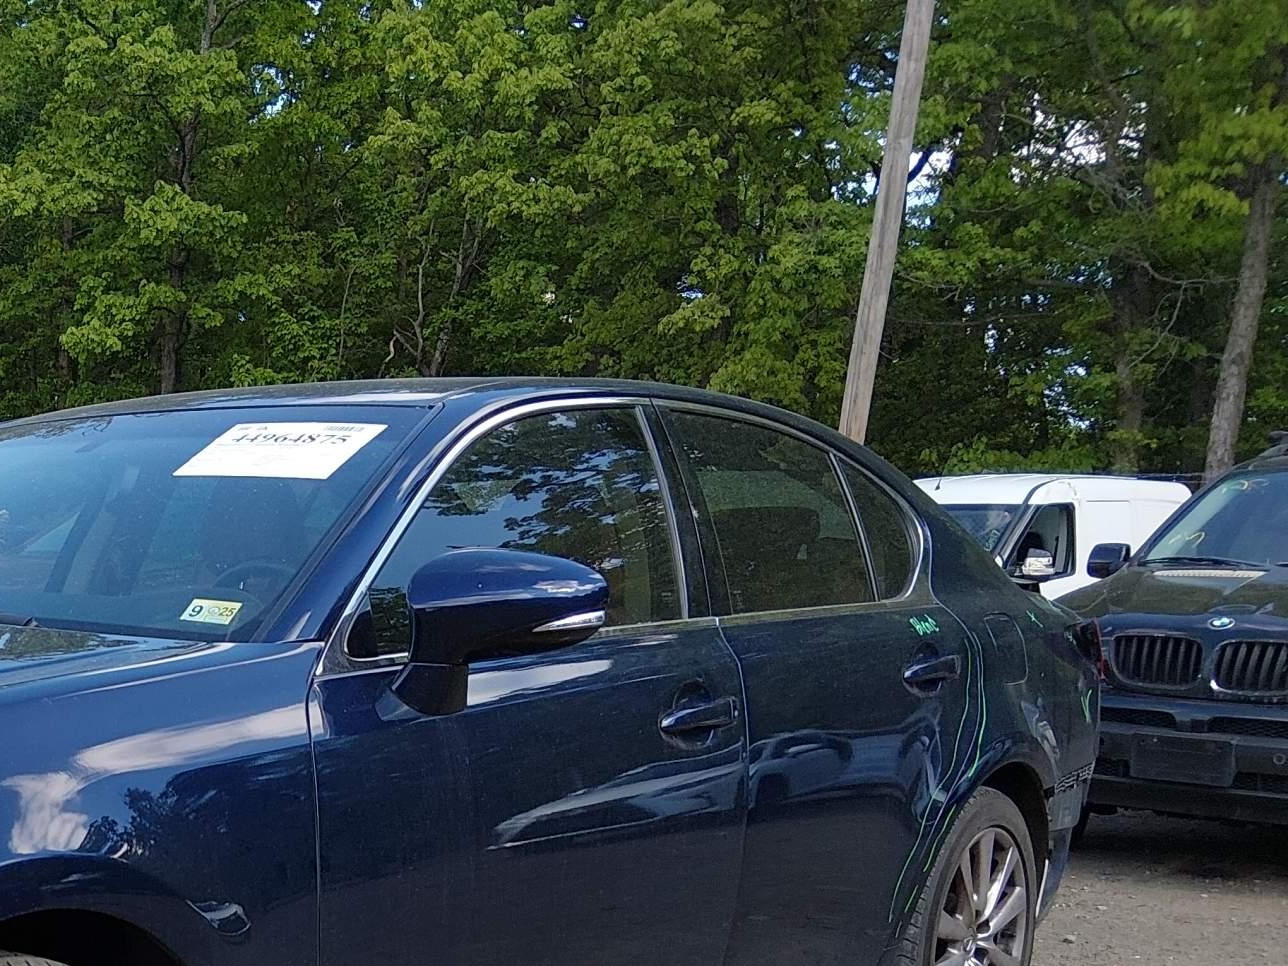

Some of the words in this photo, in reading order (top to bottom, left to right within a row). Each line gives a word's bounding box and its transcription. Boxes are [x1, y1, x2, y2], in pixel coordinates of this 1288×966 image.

[231, 432, 352, 445] 44964875
[188, 604, 204, 617] 9
[218, 606, 237, 617] 25
